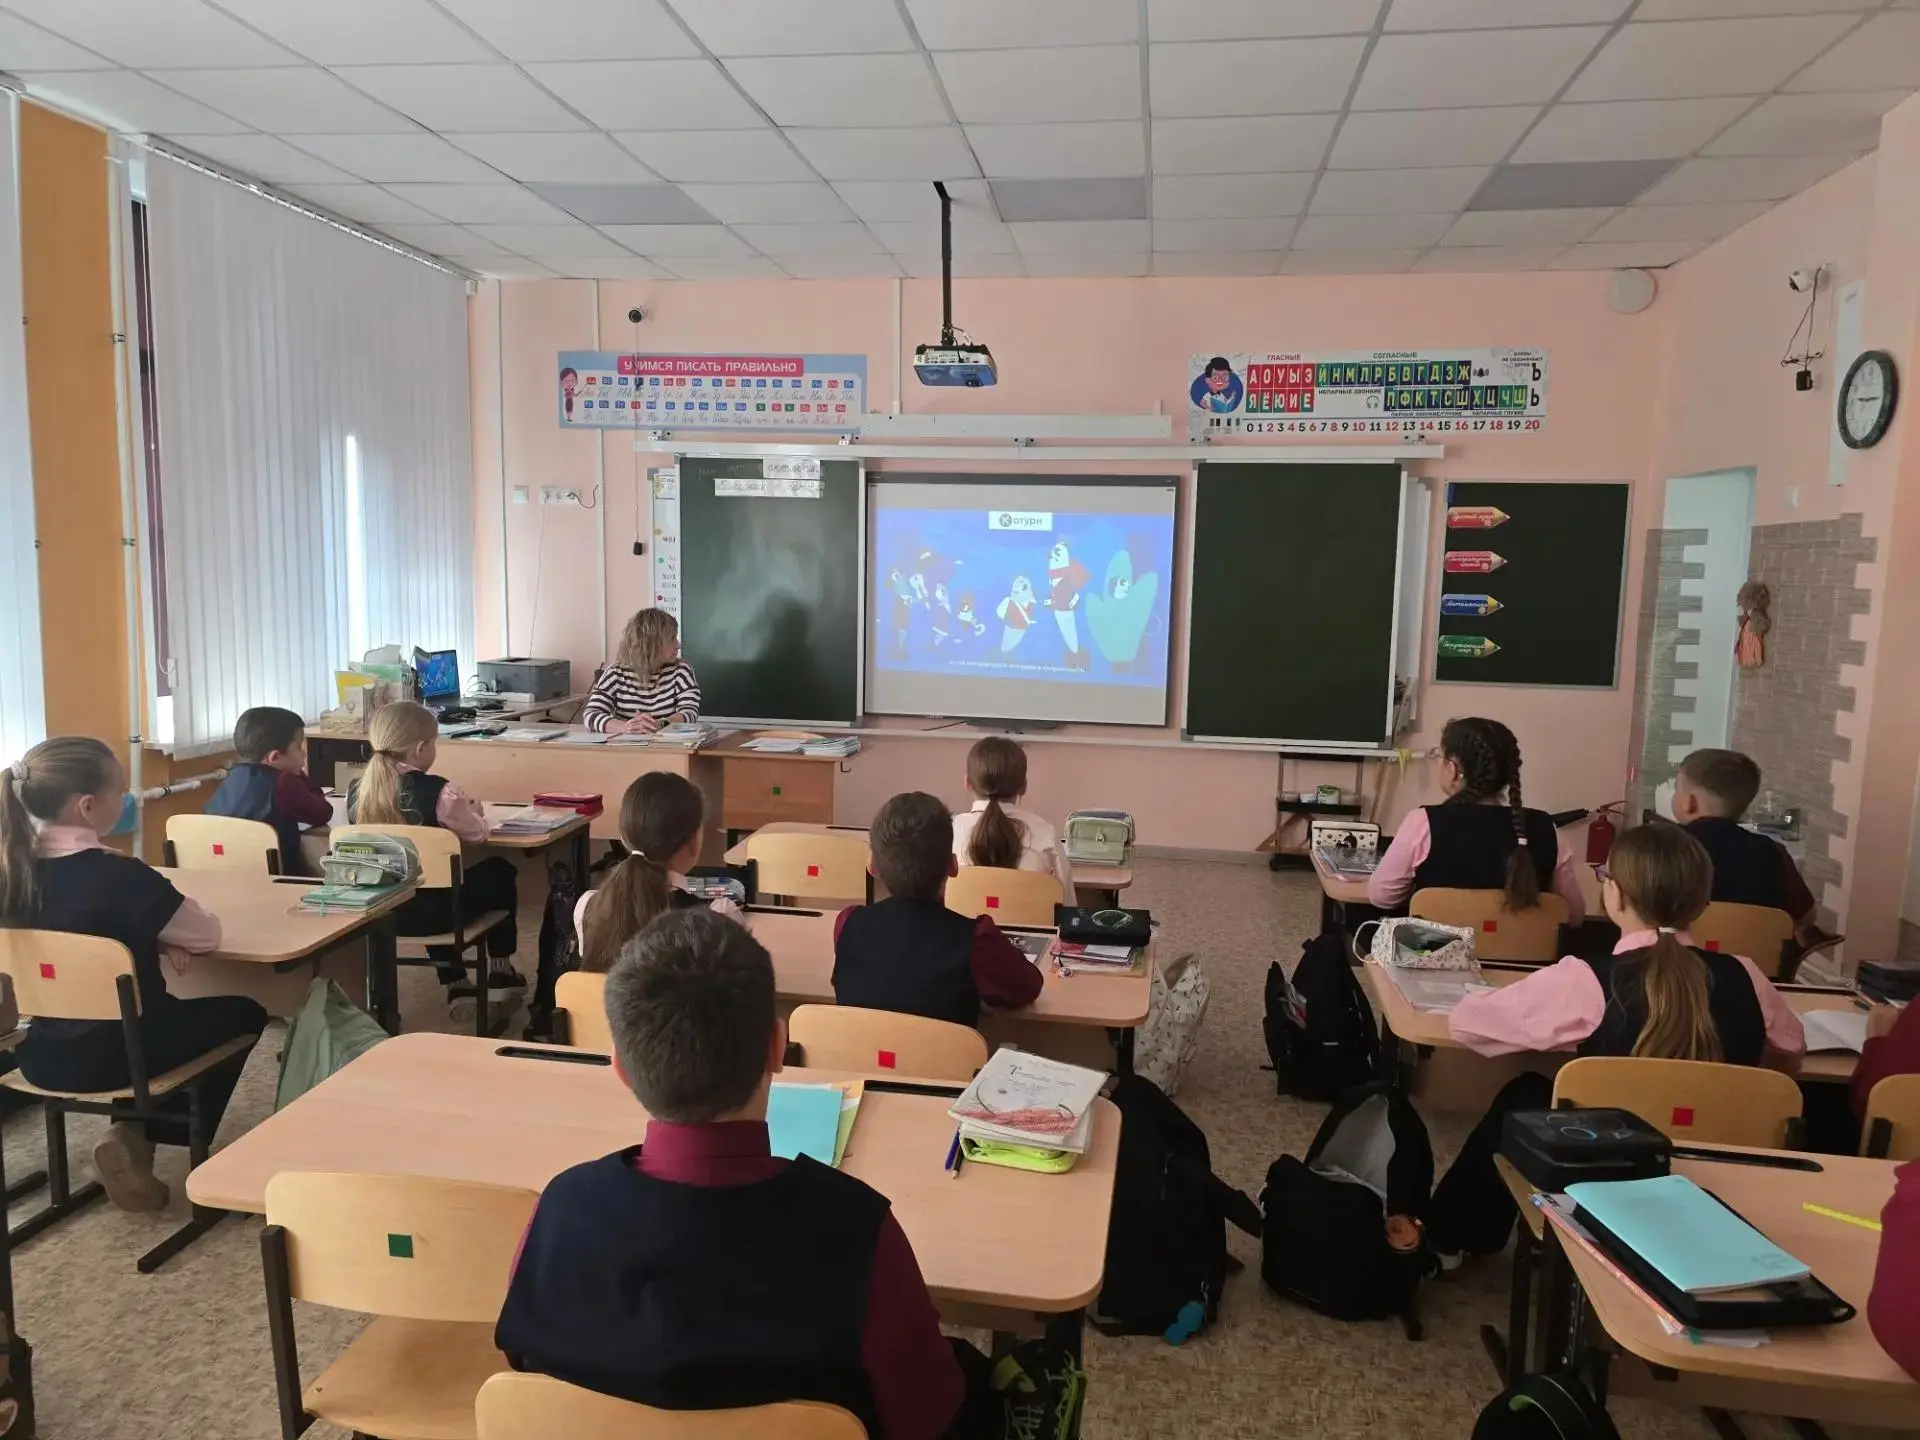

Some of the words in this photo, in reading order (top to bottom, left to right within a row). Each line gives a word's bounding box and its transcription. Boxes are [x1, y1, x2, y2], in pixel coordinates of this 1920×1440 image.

[676, 361, 721, 372] ПИСАТЬ
[725, 362, 797, 373] ПРАВИЛЬНО
[1246, 423, 1254, 433] 0
[1257, 423, 1263, 432] 1
[1267, 423, 1274, 432] 2
[1277, 423, 1284, 432] 3
[1288, 423, 1295, 432] 4
[1298, 423, 1306, 432] 5
[1309, 423, 1317, 432] 6
[1320, 423, 1328, 432] 7
[1330, 422, 1338, 432] 8
[1341, 422, 1349, 431] 9
[1352, 422, 1366, 432] 10
[1369, 422, 1381, 431] 11
[1386, 422, 1399, 431] 12
[1402, 422, 1416, 431] 13
[1420, 421, 1434, 431] 14
[1438, 421, 1451, 431] 15
[1455, 421, 1469, 431] 16
[1473, 421, 1486, 431] 17
[1490, 421, 1503, 430] 18
[1507, 420, 1521, 430] 19
[1525, 420, 1540, 430] 20
